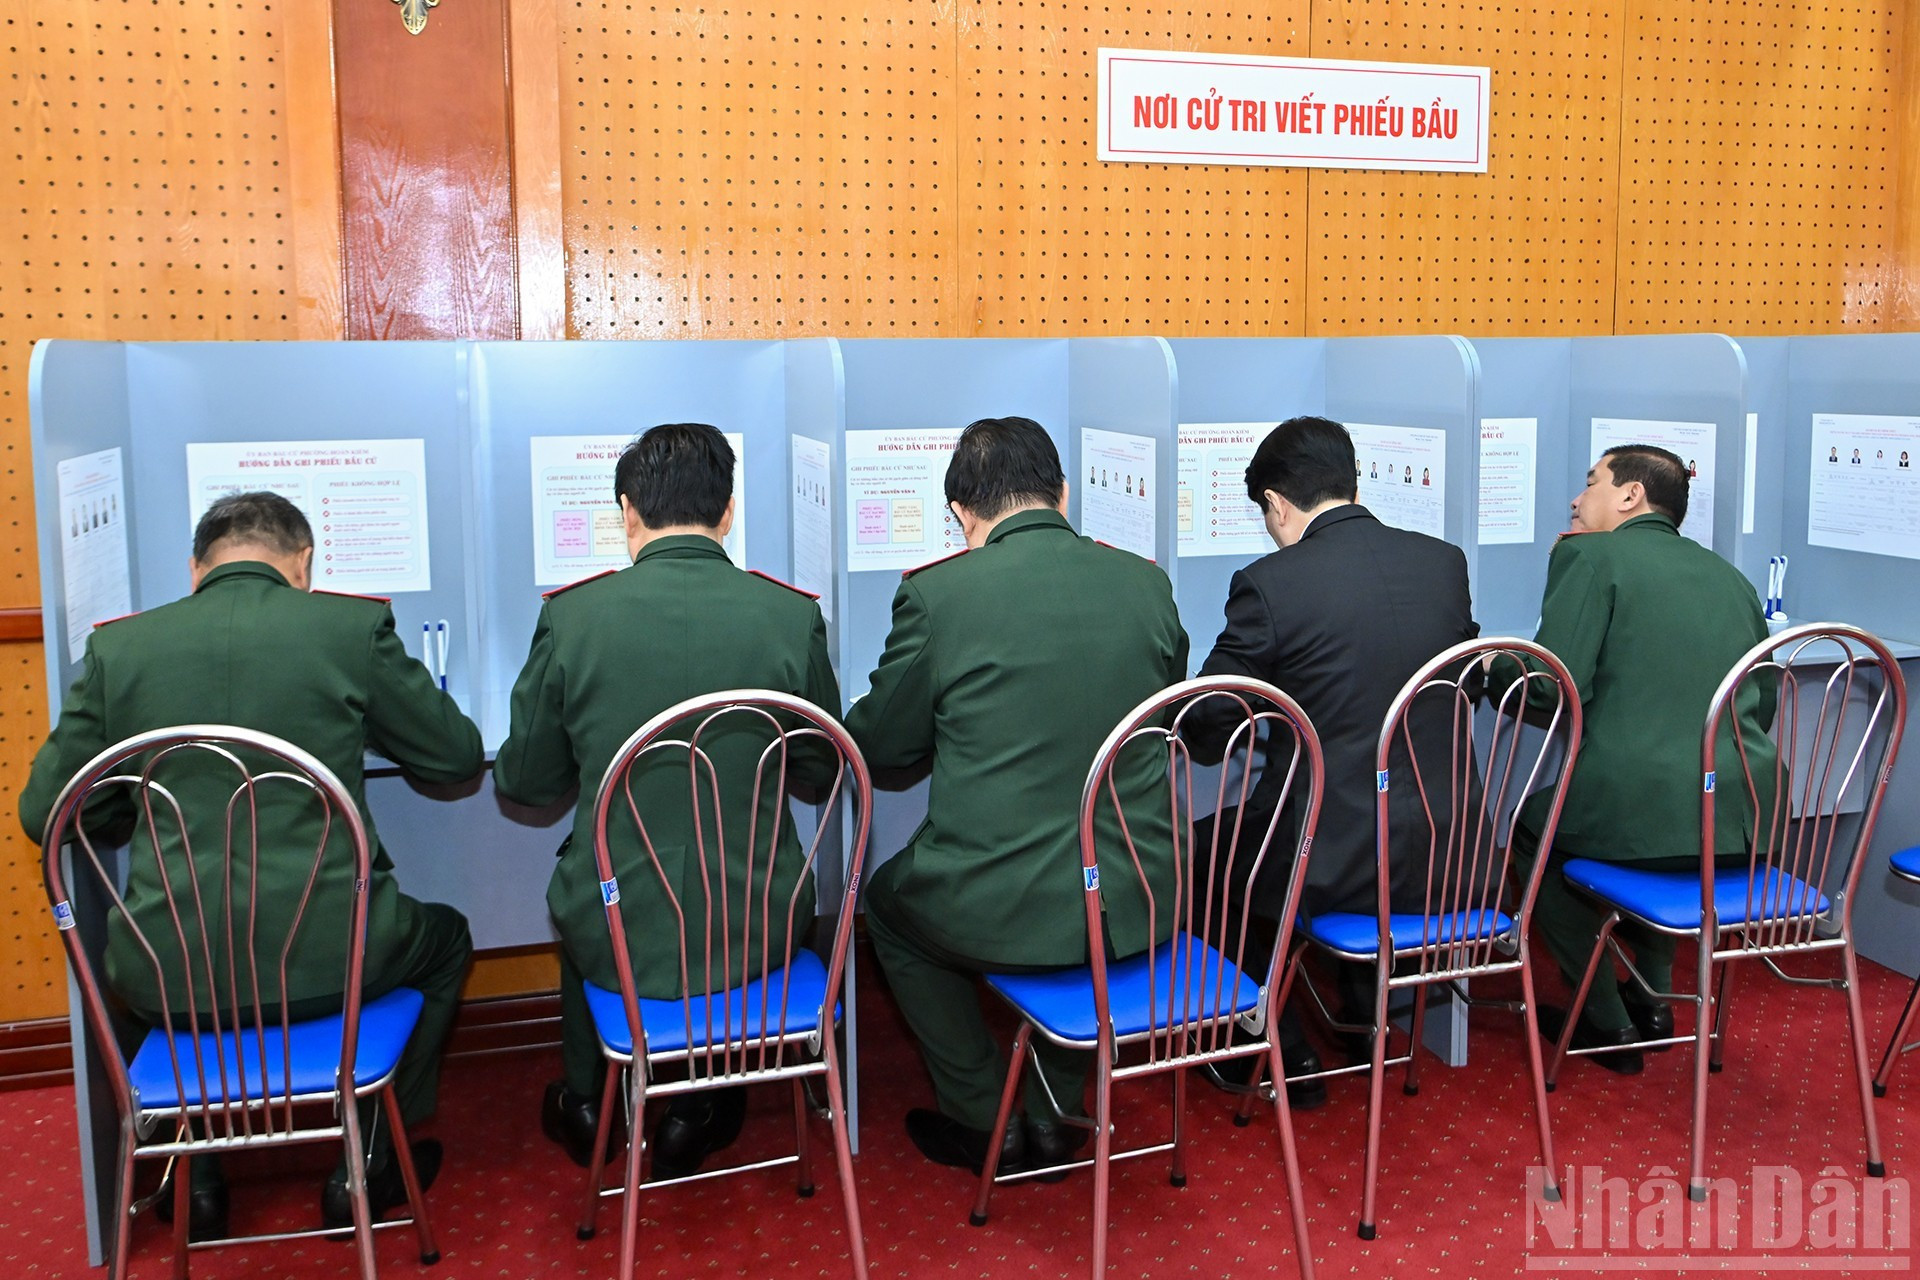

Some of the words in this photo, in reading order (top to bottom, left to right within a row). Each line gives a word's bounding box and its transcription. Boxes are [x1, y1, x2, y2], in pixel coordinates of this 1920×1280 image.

[1133, 92, 1178, 129] NƠI
[1186, 87, 1223, 131] CỬ
[1228, 99, 1266, 132] TRI
[1274, 92, 1327, 134] VIẾT
[1333, 95, 1404, 137] PHIẾU
[1411, 97, 1458, 139] BẦU
[1302, 837, 1312, 855] INOX
